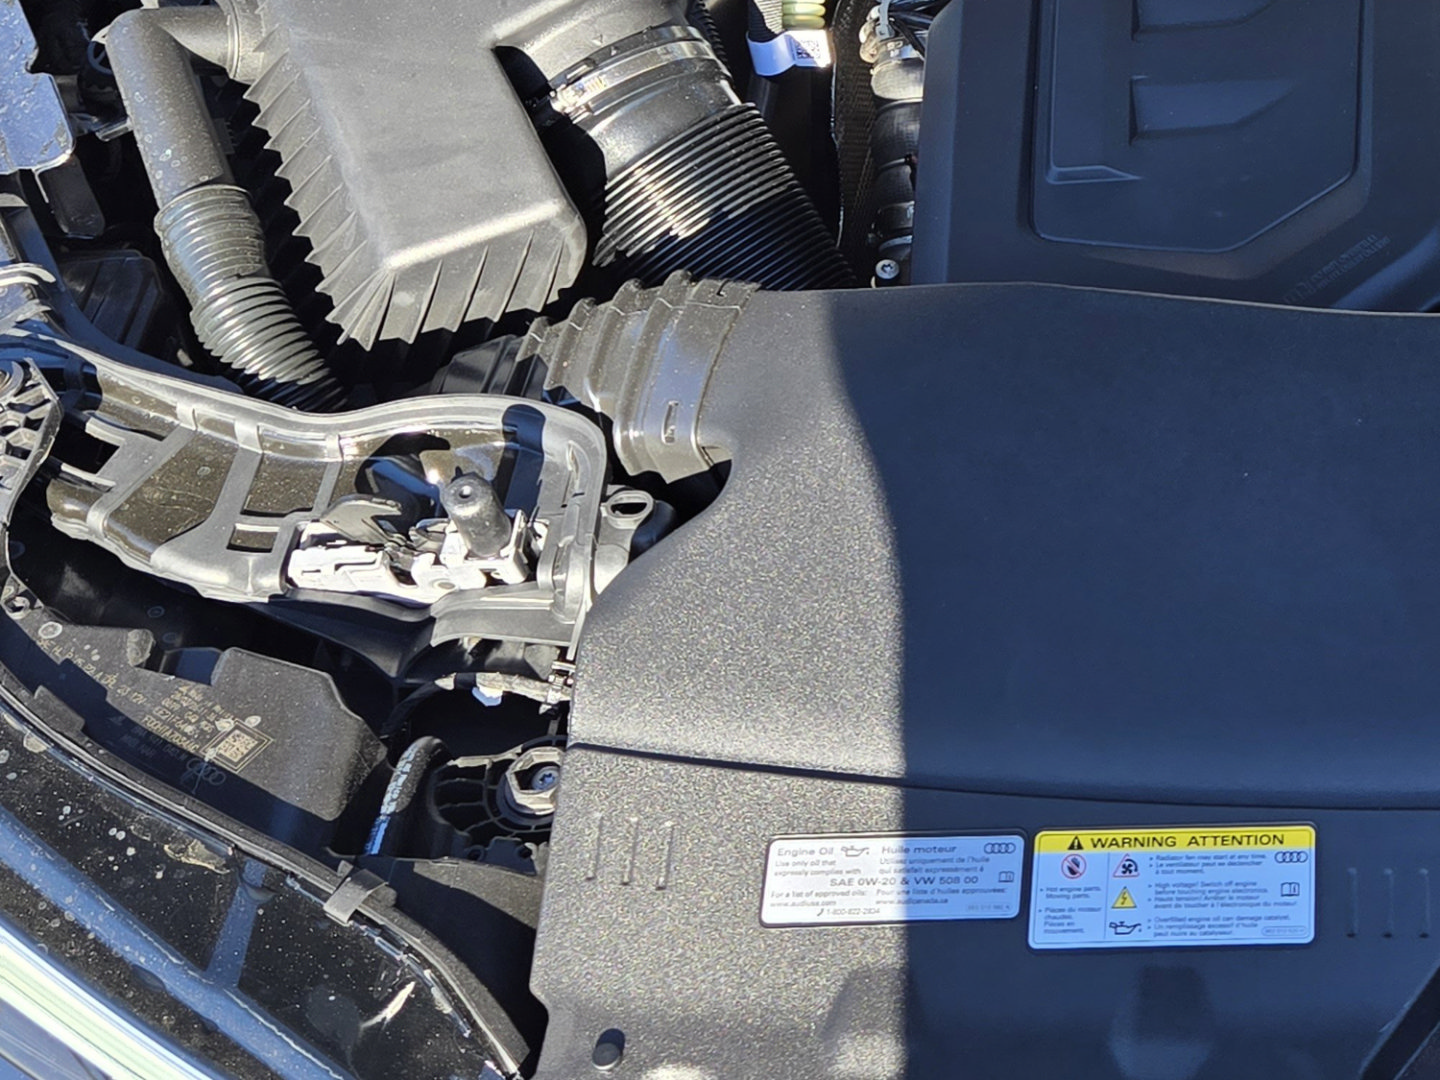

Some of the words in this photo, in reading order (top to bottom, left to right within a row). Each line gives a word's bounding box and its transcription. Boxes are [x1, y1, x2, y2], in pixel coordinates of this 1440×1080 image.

[1091, 836, 1177, 848] WARNING
[1188, 834, 1284, 846] ATTENTION
[777, 848, 815, 856] Engine
[819, 847, 833, 855] Oil
[881, 846, 910, 855] Huile
[830, 878, 854, 886] SAE
[858, 877, 896, 886] 0W-20
[901, 877, 910, 885] &
[939, 876, 960, 884] 508
